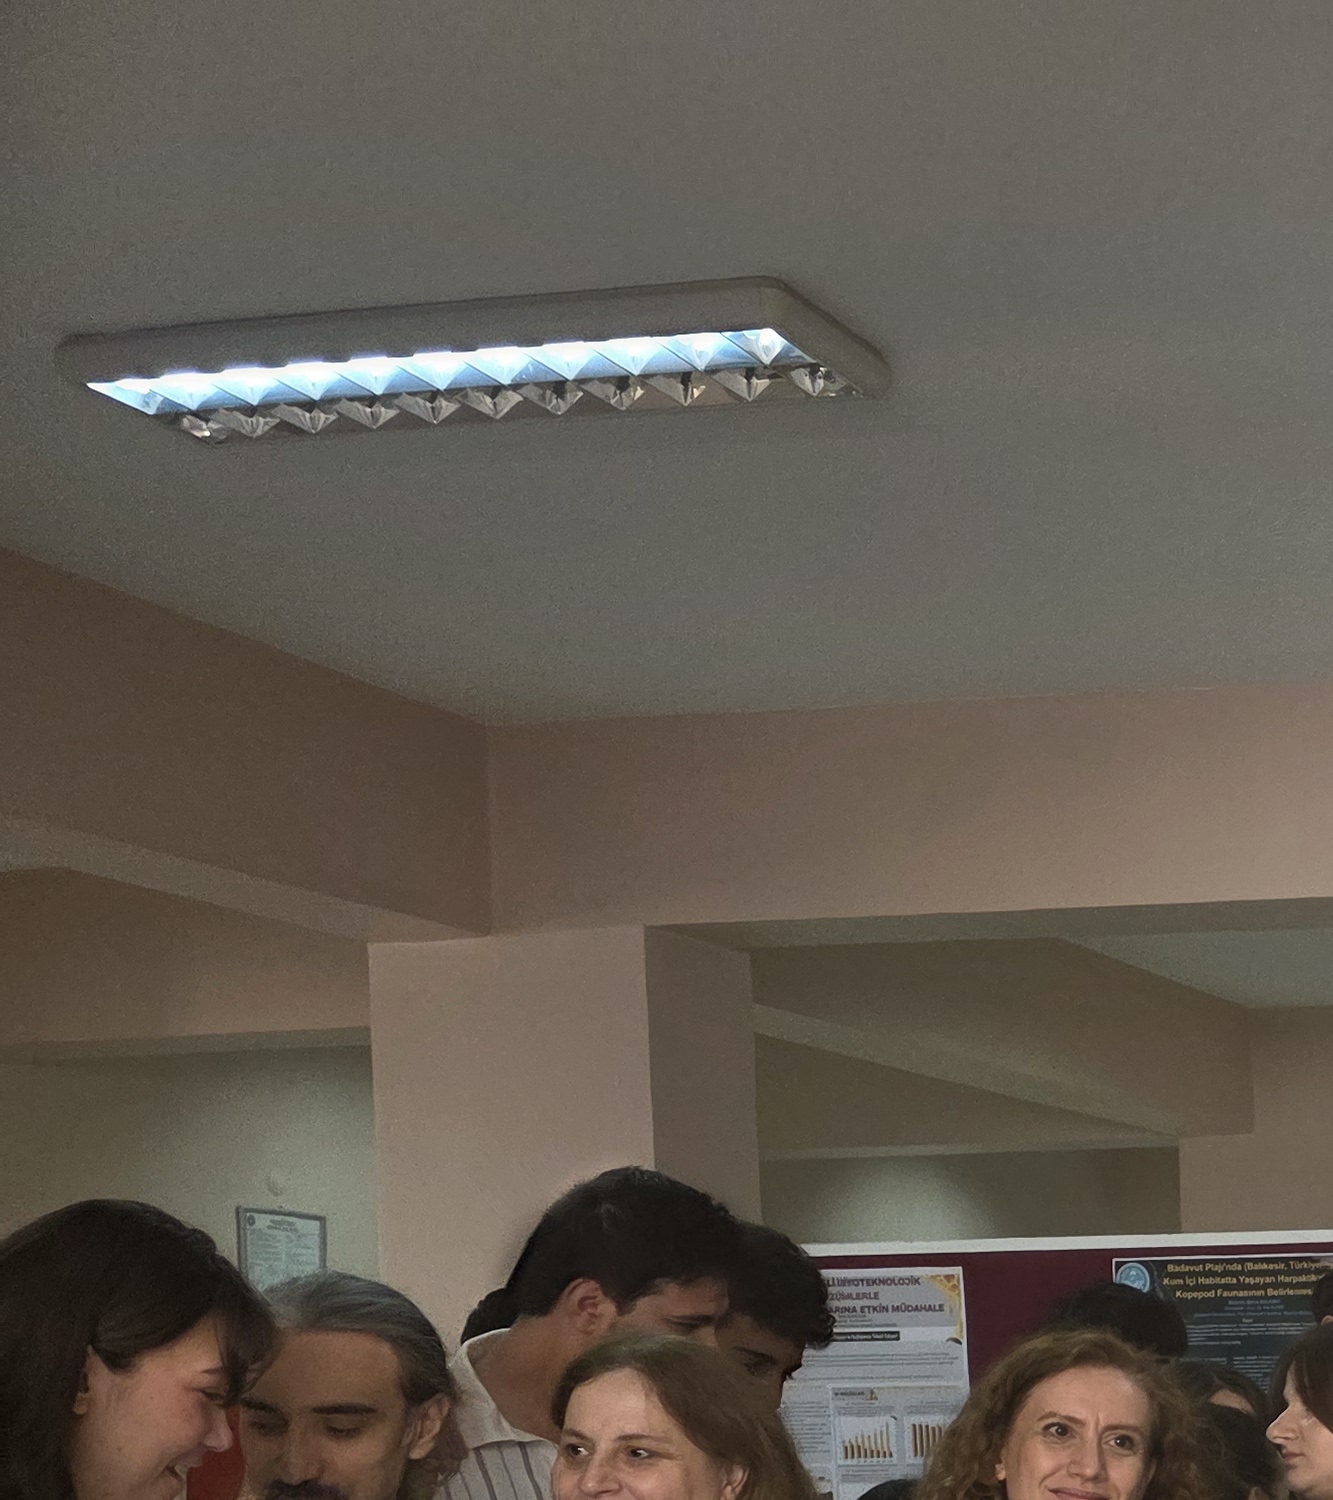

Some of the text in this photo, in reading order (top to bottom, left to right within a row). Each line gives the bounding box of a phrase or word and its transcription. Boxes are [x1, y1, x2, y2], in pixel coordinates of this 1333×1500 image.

[1166, 1263, 1203, 1273] Badavut
[1162, 1277, 1184, 1286] Kum
[1198, 1276, 1238, 1286] Habitatta
[1239, 1275, 1276, 1286] Yaşayan
[1175, 1289, 1215, 1300] Kopepod
[1217, 1288, 1265, 1298] Faunasının
[860, 1303, 889, 1314] ETKİN
[891, 1302, 945, 1314] MÜDAHALE
